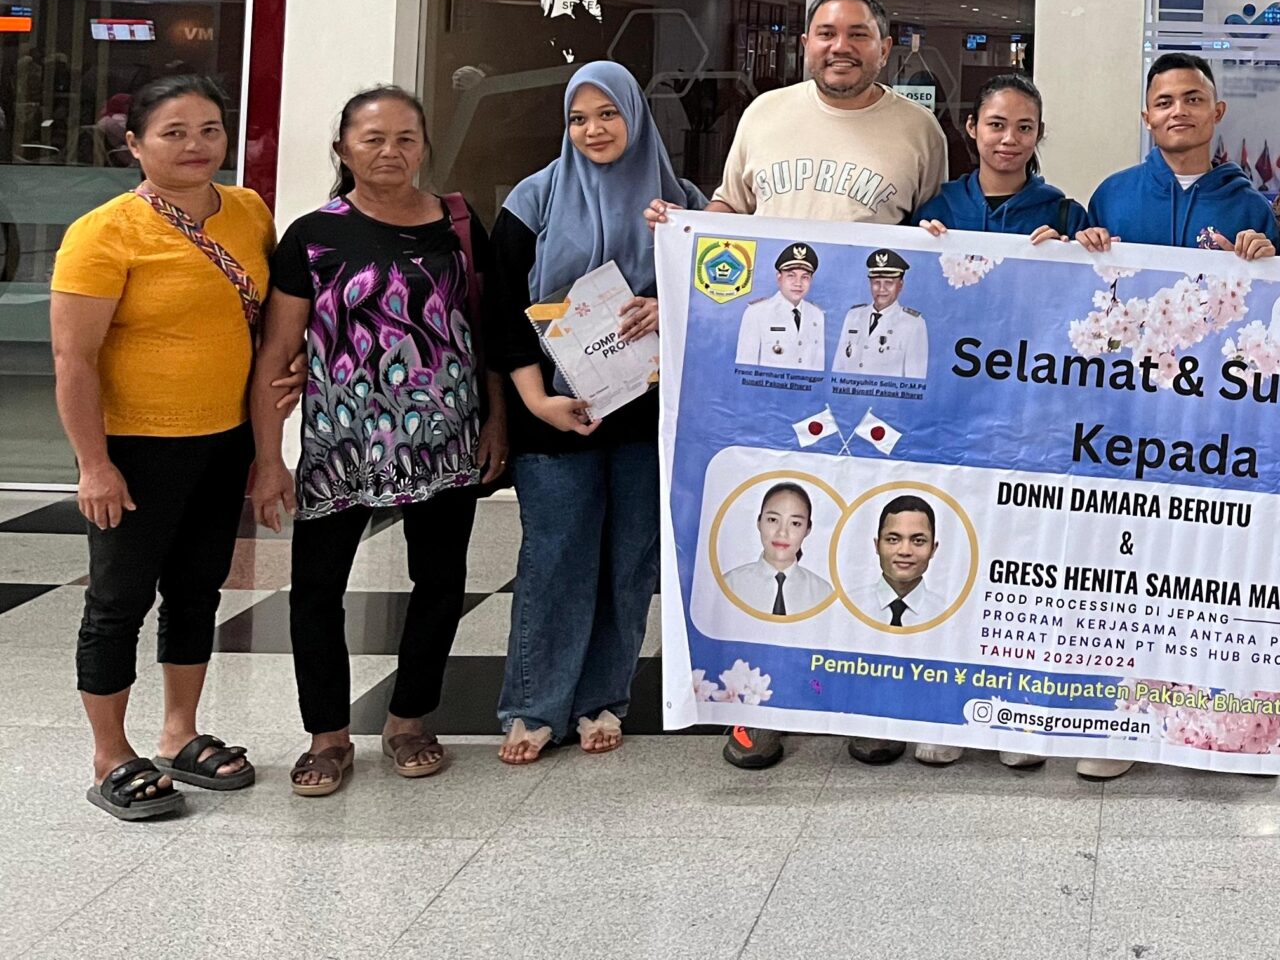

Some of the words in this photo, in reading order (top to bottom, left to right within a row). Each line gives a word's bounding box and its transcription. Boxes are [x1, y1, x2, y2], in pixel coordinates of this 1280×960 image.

[898, 92, 932, 101] OSED
[755, 158, 897, 214] SUPREME
[952, 337, 1158, 393] Selamat
[1172, 355, 1204, 397] &
[1072, 422, 1259, 480] Kepada
[997, 481, 1064, 510] DONNI
[1070, 488, 1160, 518] DAMARA
[1168, 496, 1252, 528] BERUTU
[1119, 530, 1134, 556] &
[989, 559, 1058, 589] GRESS
[1064, 566, 1138, 595] HENITA
[1145, 573, 1242, 606] SAMARIA
[985, 592, 1028, 605] FOOD
[1035, 596, 1138, 614] PROCESSING
[1145, 606, 1160, 617] DI
[1168, 608, 1230, 624] JEPANG
[981, 627, 1048, 644] BHARAT
[1057, 635, 1126, 650] DENGAN
[1135, 641, 1155, 652] PT
[1165, 644, 1198, 657] MSS
[1208, 649, 1240, 662] HUB
[983, 610, 1064, 627] PROGRAM
[1076, 618, 1177, 637] KERJASAMA
[1190, 629, 1257, 646] ANTARA
[980, 644, 1036, 660] TAHUN
[1043, 651, 1135, 668] 2023/2024
[811, 655, 904, 680] Pemburu
[910, 663, 948, 683] Yen
[954, 668, 968, 685] ¥
[972, 670, 1012, 690] dari
[1018, 674, 1129, 701] Kabupaten
[1135, 683, 1211, 711] Pakpak
[997, 708, 1150, 734] @mssgroupmedan
